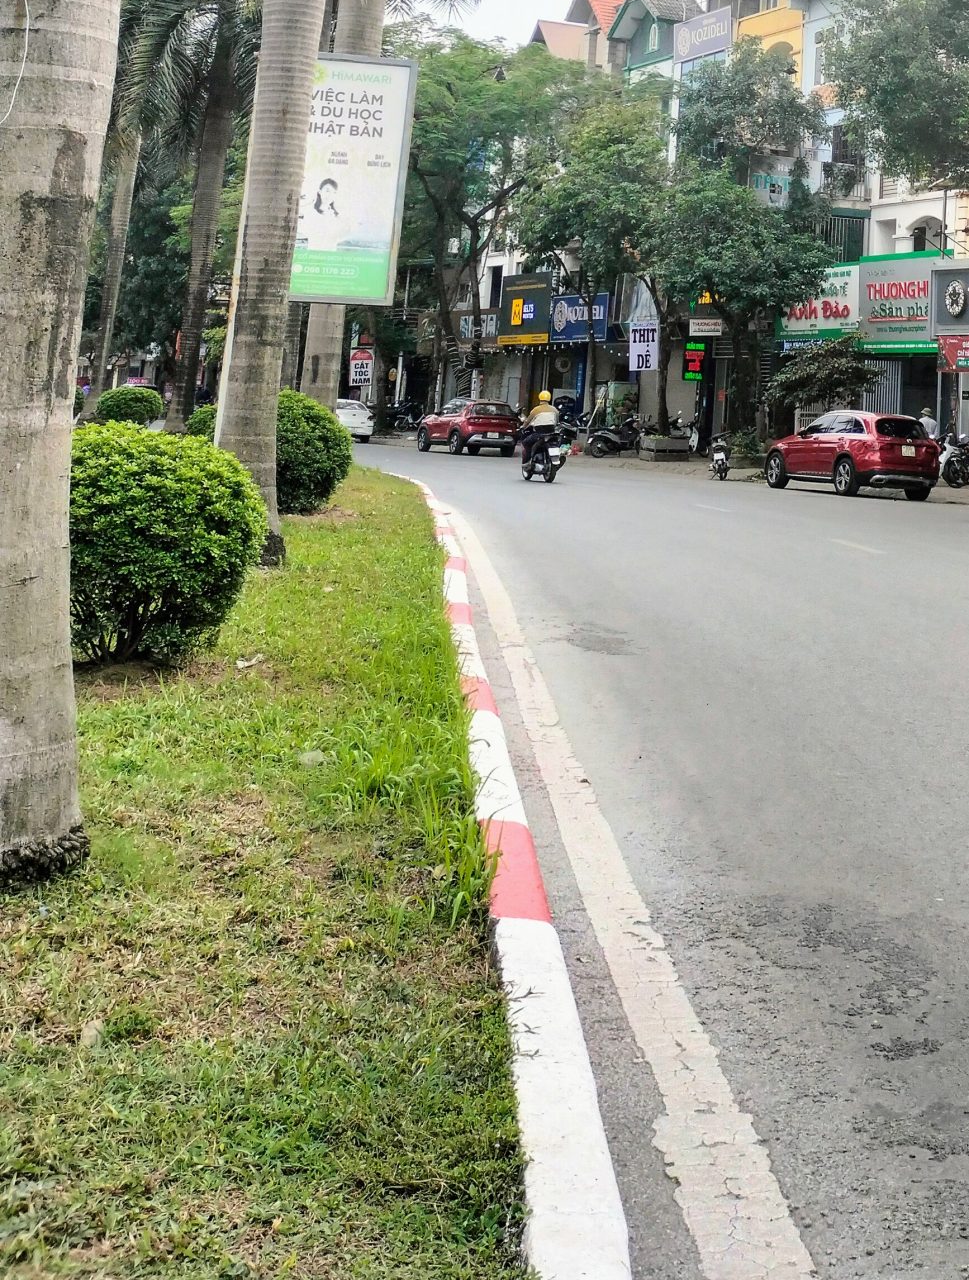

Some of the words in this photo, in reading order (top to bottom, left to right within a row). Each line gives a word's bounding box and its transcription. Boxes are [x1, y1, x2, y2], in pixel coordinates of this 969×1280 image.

[691, 20, 728, 46] KOZIDELI
[331, 69, 392, 84] HIMAWARI
[311, 88, 345, 105] VIỆC
[350, 90, 384, 106] LÀM
[321, 106, 343, 118] DU
[348, 108, 383, 122] HỌC
[350, 122, 384, 138] BẢN
[631, 327, 657, 348] THỊT
[637, 349, 652, 369] DÊ
[352, 377, 371, 385] NAM
